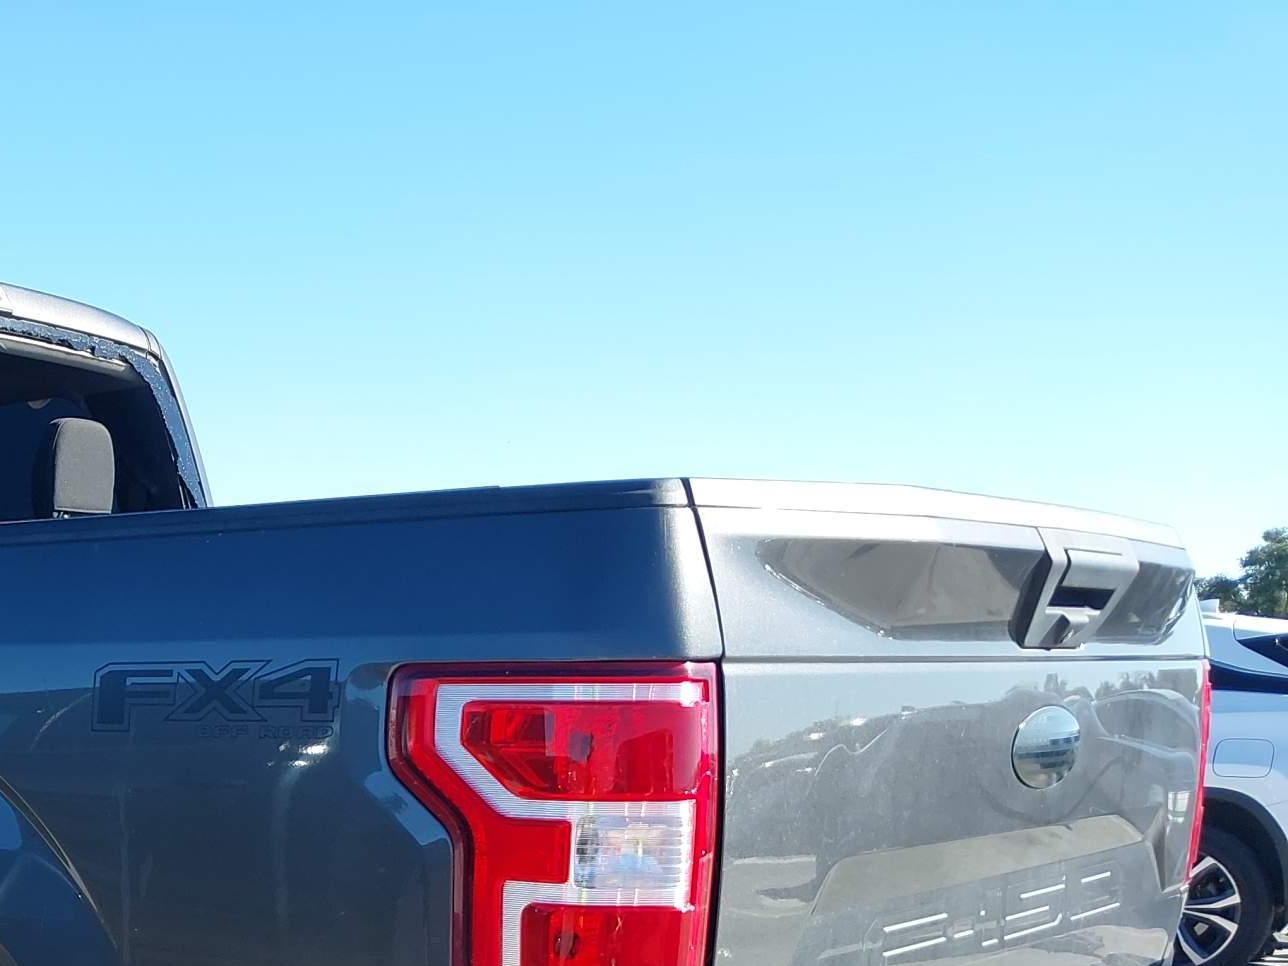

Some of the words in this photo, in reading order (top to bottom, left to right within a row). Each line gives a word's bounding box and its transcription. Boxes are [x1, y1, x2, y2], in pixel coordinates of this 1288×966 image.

[92, 659, 340, 732] FX4
[196, 725, 249, 738] OFF
[258, 725, 334, 739] ROAD
